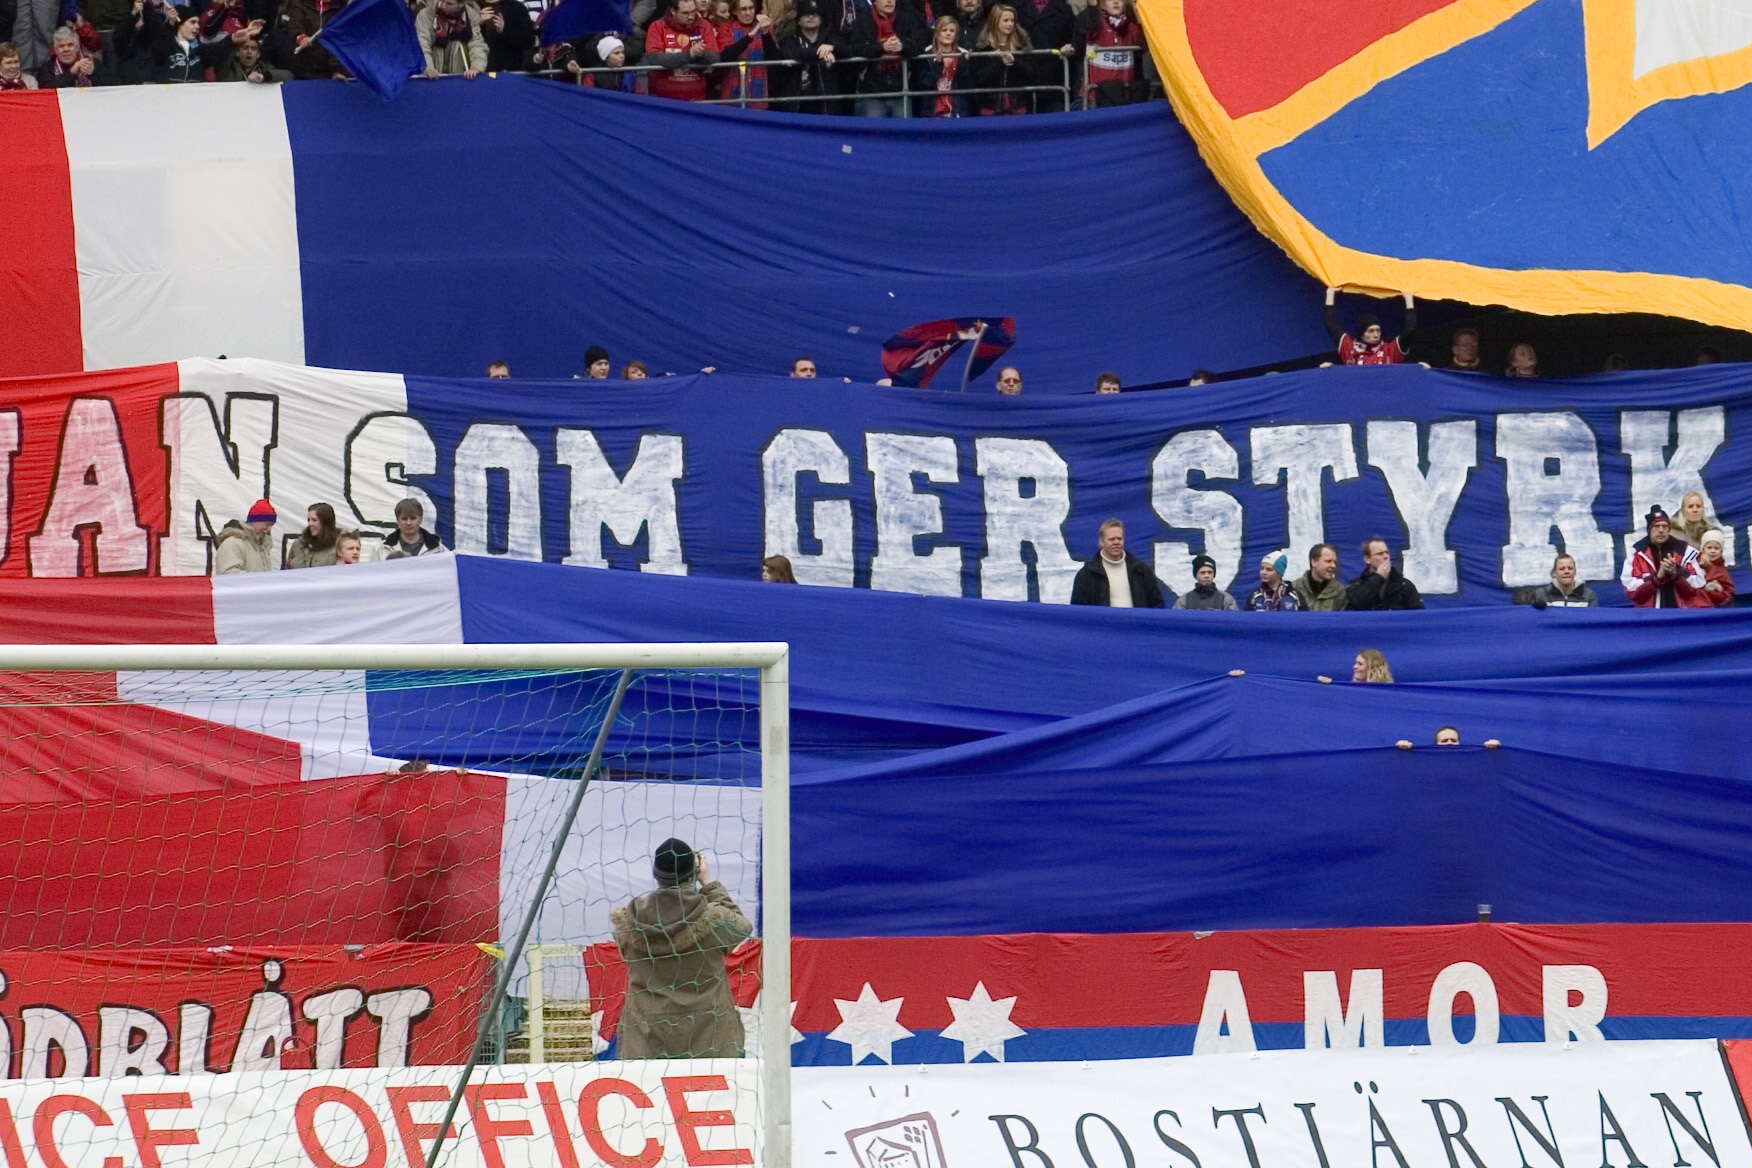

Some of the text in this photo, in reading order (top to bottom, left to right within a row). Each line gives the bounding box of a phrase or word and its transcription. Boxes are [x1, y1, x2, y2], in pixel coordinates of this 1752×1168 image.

[343, 409, 689, 577] SOM
[761, 428, 1086, 604] GER
[1192, 962, 1609, 1055] AMOR
[295, 1074, 754, 1168] OFFICE
